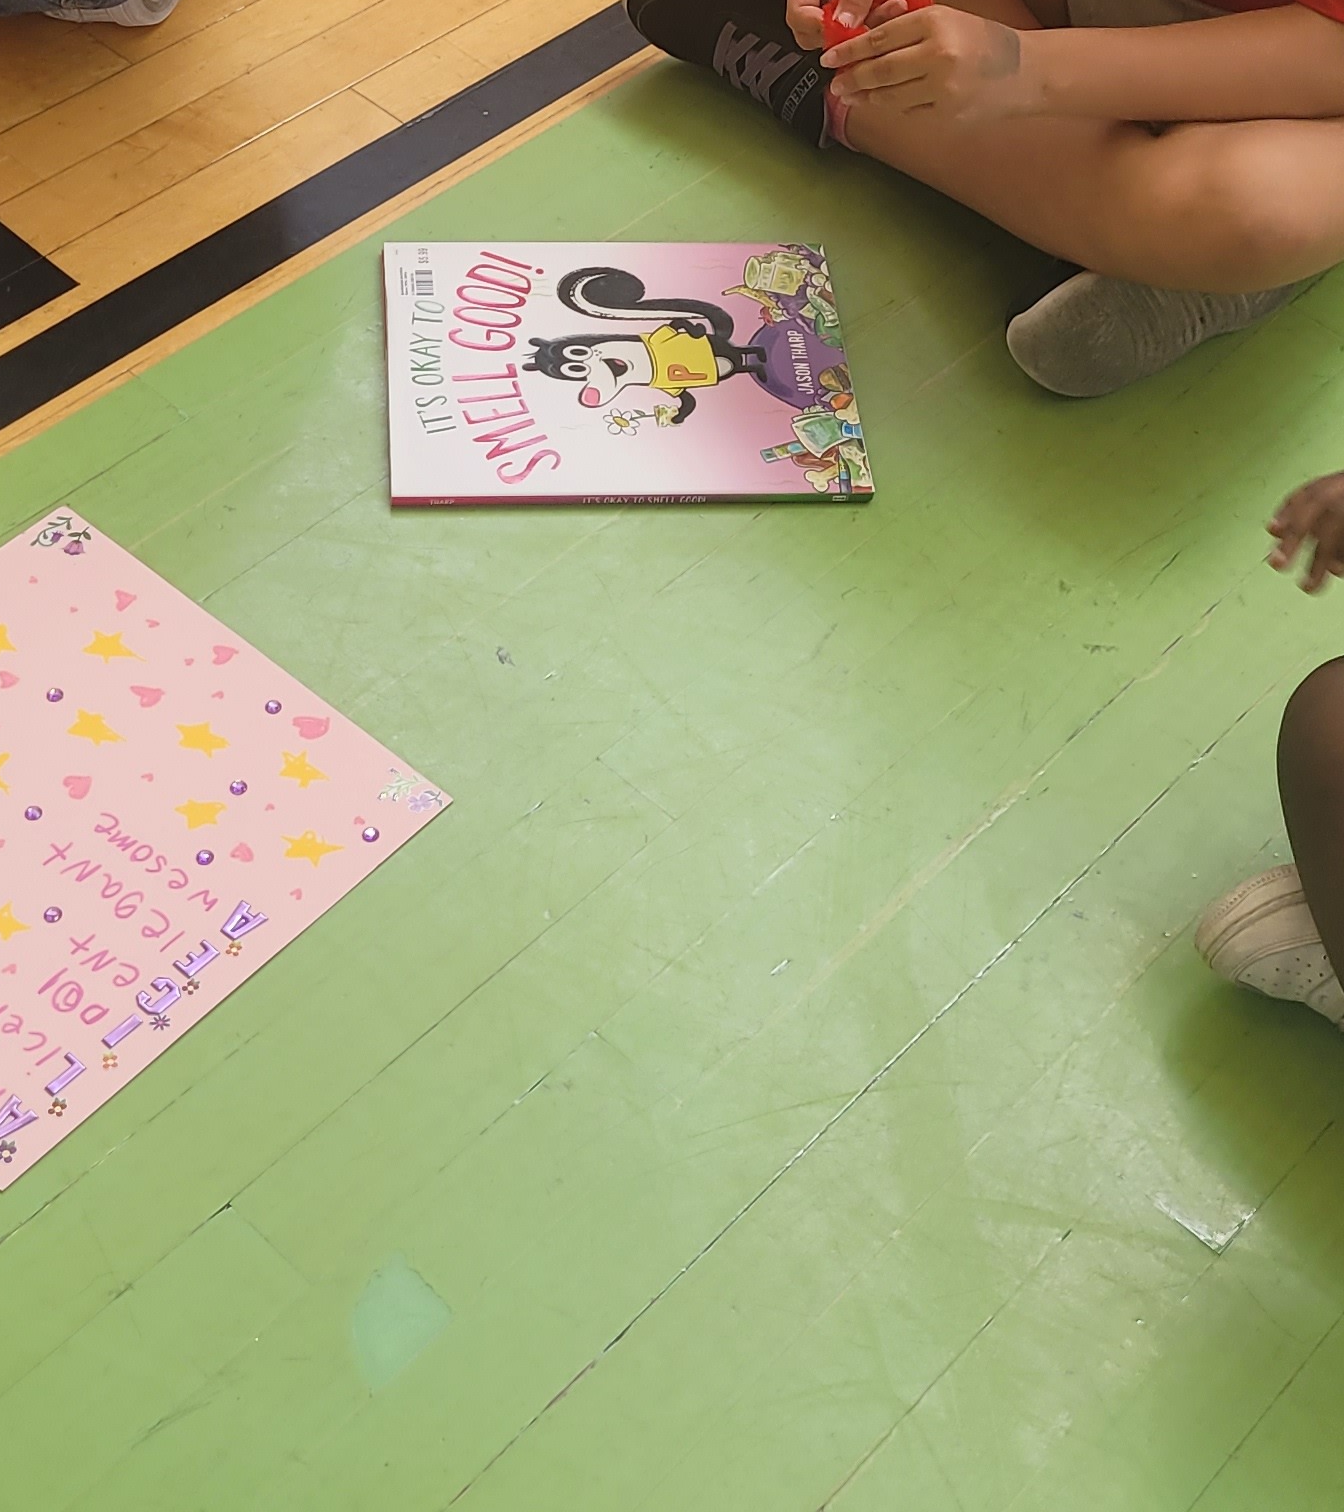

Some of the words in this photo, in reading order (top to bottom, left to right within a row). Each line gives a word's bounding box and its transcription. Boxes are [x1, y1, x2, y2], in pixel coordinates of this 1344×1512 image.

[416, 246, 431, 265] $5.99
[409, 299, 447, 327] TO
[446, 249, 546, 353] GOOD!
[408, 331, 447, 387] OKAY
[791, 328, 812, 357] THARP
[667, 363, 708, 383] P
[793, 359, 816, 396] JASON
[413, 394, 458, 435] IT'S
[449, 362, 562, 485] SMELL
